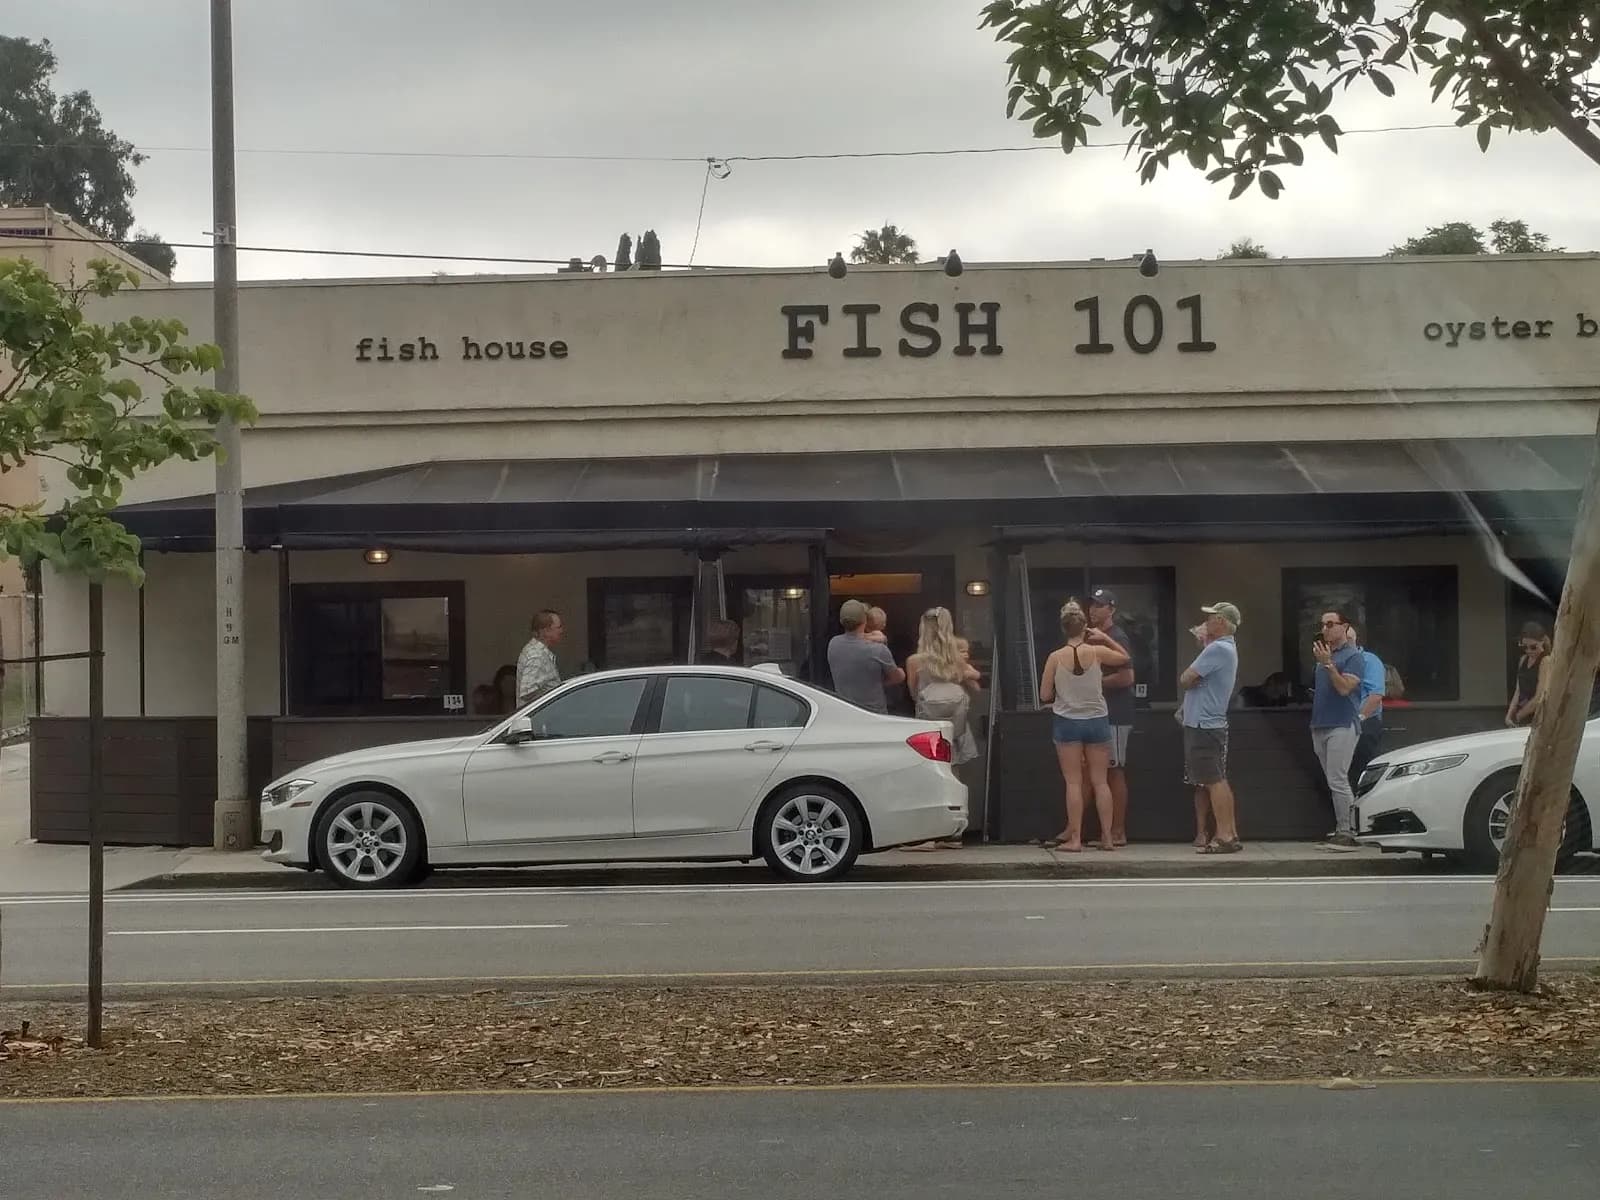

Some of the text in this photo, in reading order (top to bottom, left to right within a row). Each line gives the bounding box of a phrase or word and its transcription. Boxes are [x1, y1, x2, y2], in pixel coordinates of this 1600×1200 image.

[781, 294, 1217, 359] FISH 101
[1423, 315, 1554, 347] oyster
[355, 336, 569, 361] fish house
